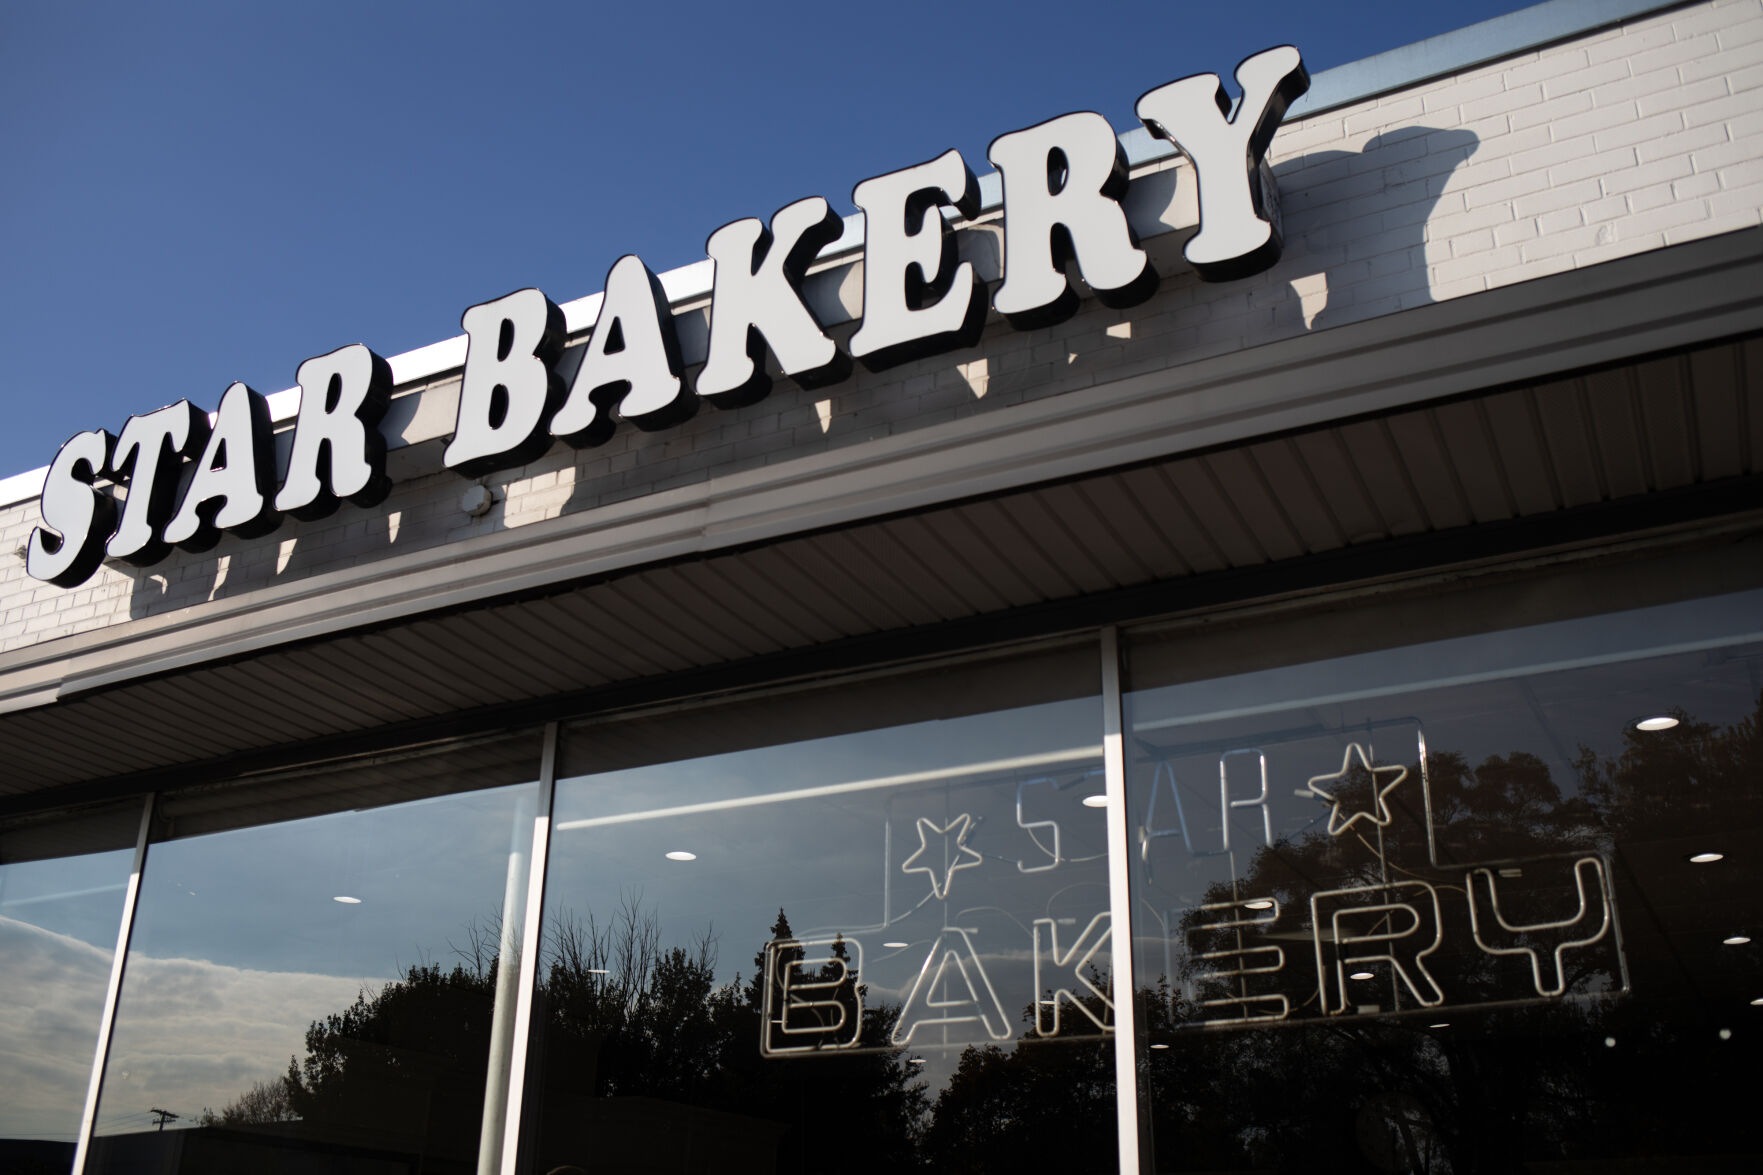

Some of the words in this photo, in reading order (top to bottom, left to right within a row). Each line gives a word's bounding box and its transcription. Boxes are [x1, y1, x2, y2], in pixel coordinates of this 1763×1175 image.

[27, 344, 386, 586] STAR
[444, 45, 1304, 471] BAKERY
[764, 856, 1611, 1054] BAKERY
